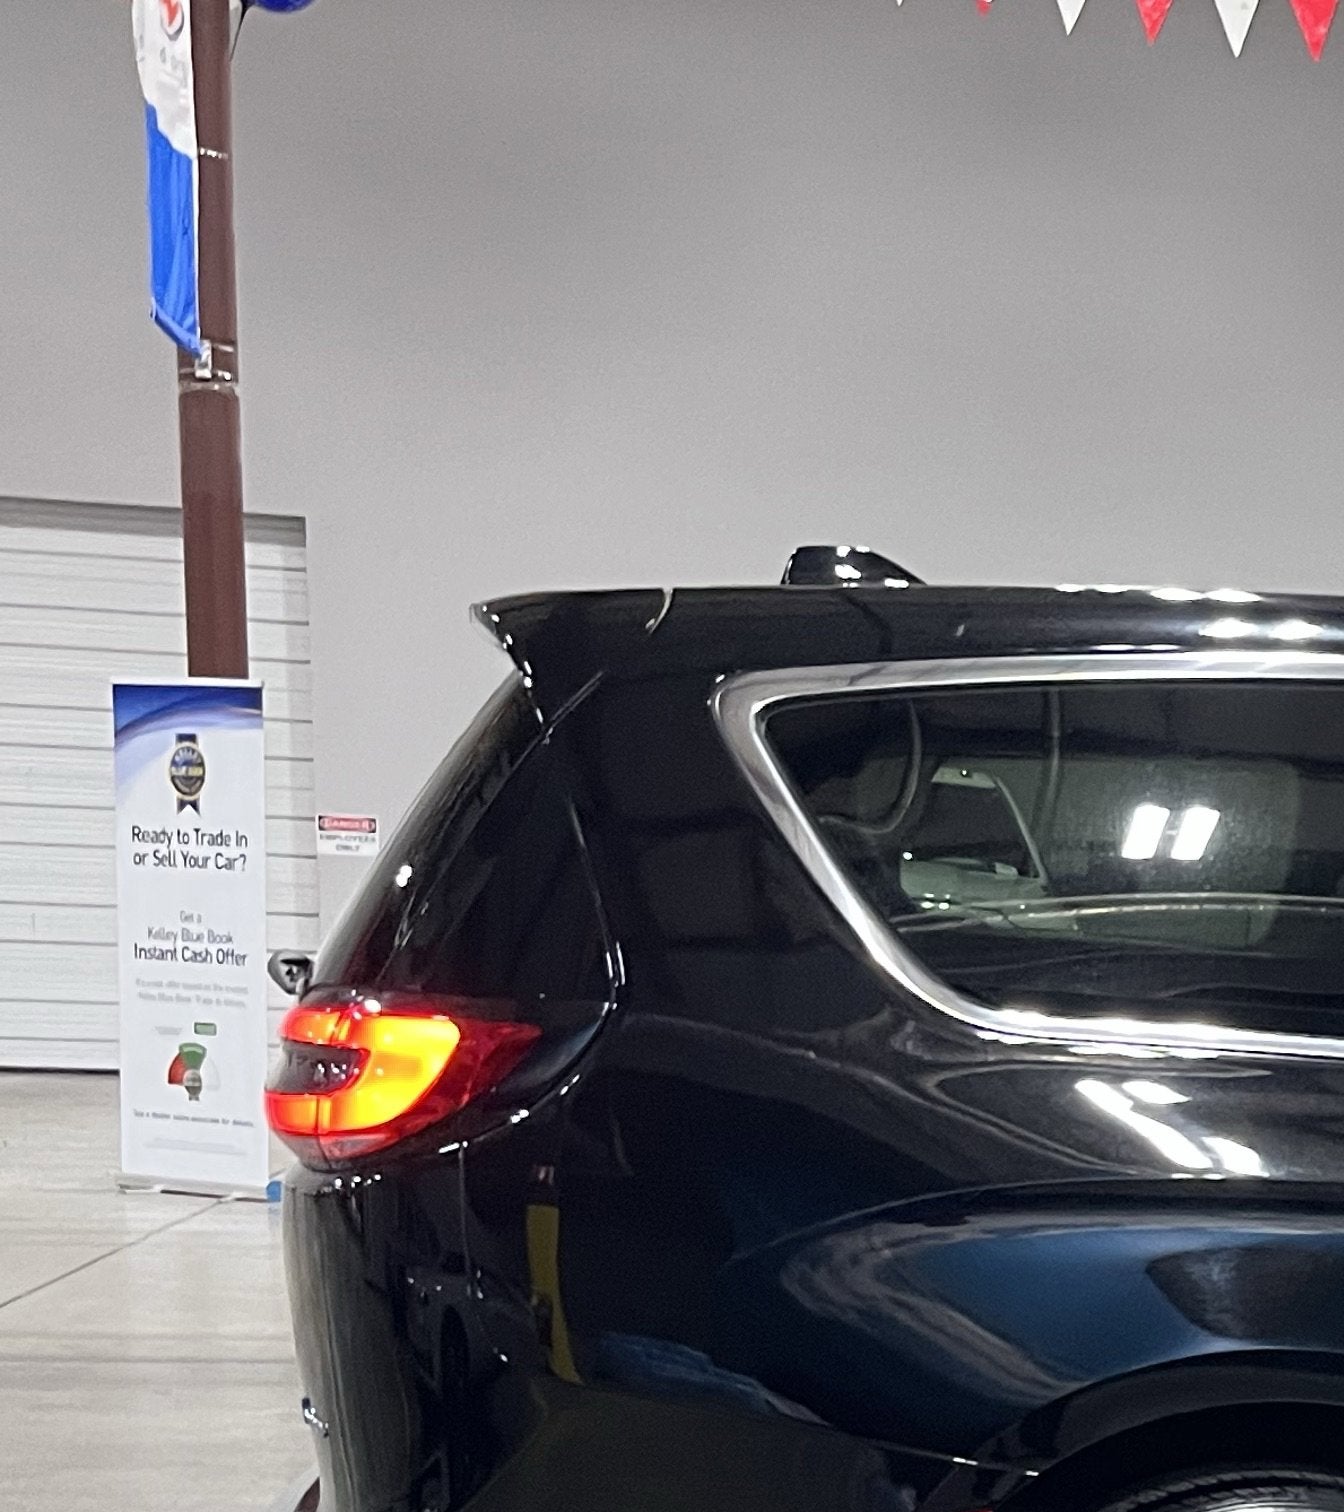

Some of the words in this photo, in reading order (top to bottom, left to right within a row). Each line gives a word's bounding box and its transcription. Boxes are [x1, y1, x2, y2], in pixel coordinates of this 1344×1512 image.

[131, 825, 173, 848] Ready
[177, 828, 190, 845] to
[193, 828, 232, 847] Trade
[235, 830, 248, 848] In
[133, 852, 149, 866] or
[152, 849, 177, 868] Sell
[180, 850, 211, 869] Your
[214, 852, 247, 872] Car?
[179, 910, 194, 923] Get
[147, 925, 178, 946] Kelley
[181, 927, 205, 943] Blue
[207, 928, 233, 944] Book
[133, 942, 179, 962] Instant
[181, 946, 213, 964] Cash
[215, 948, 248, 967] Offer
